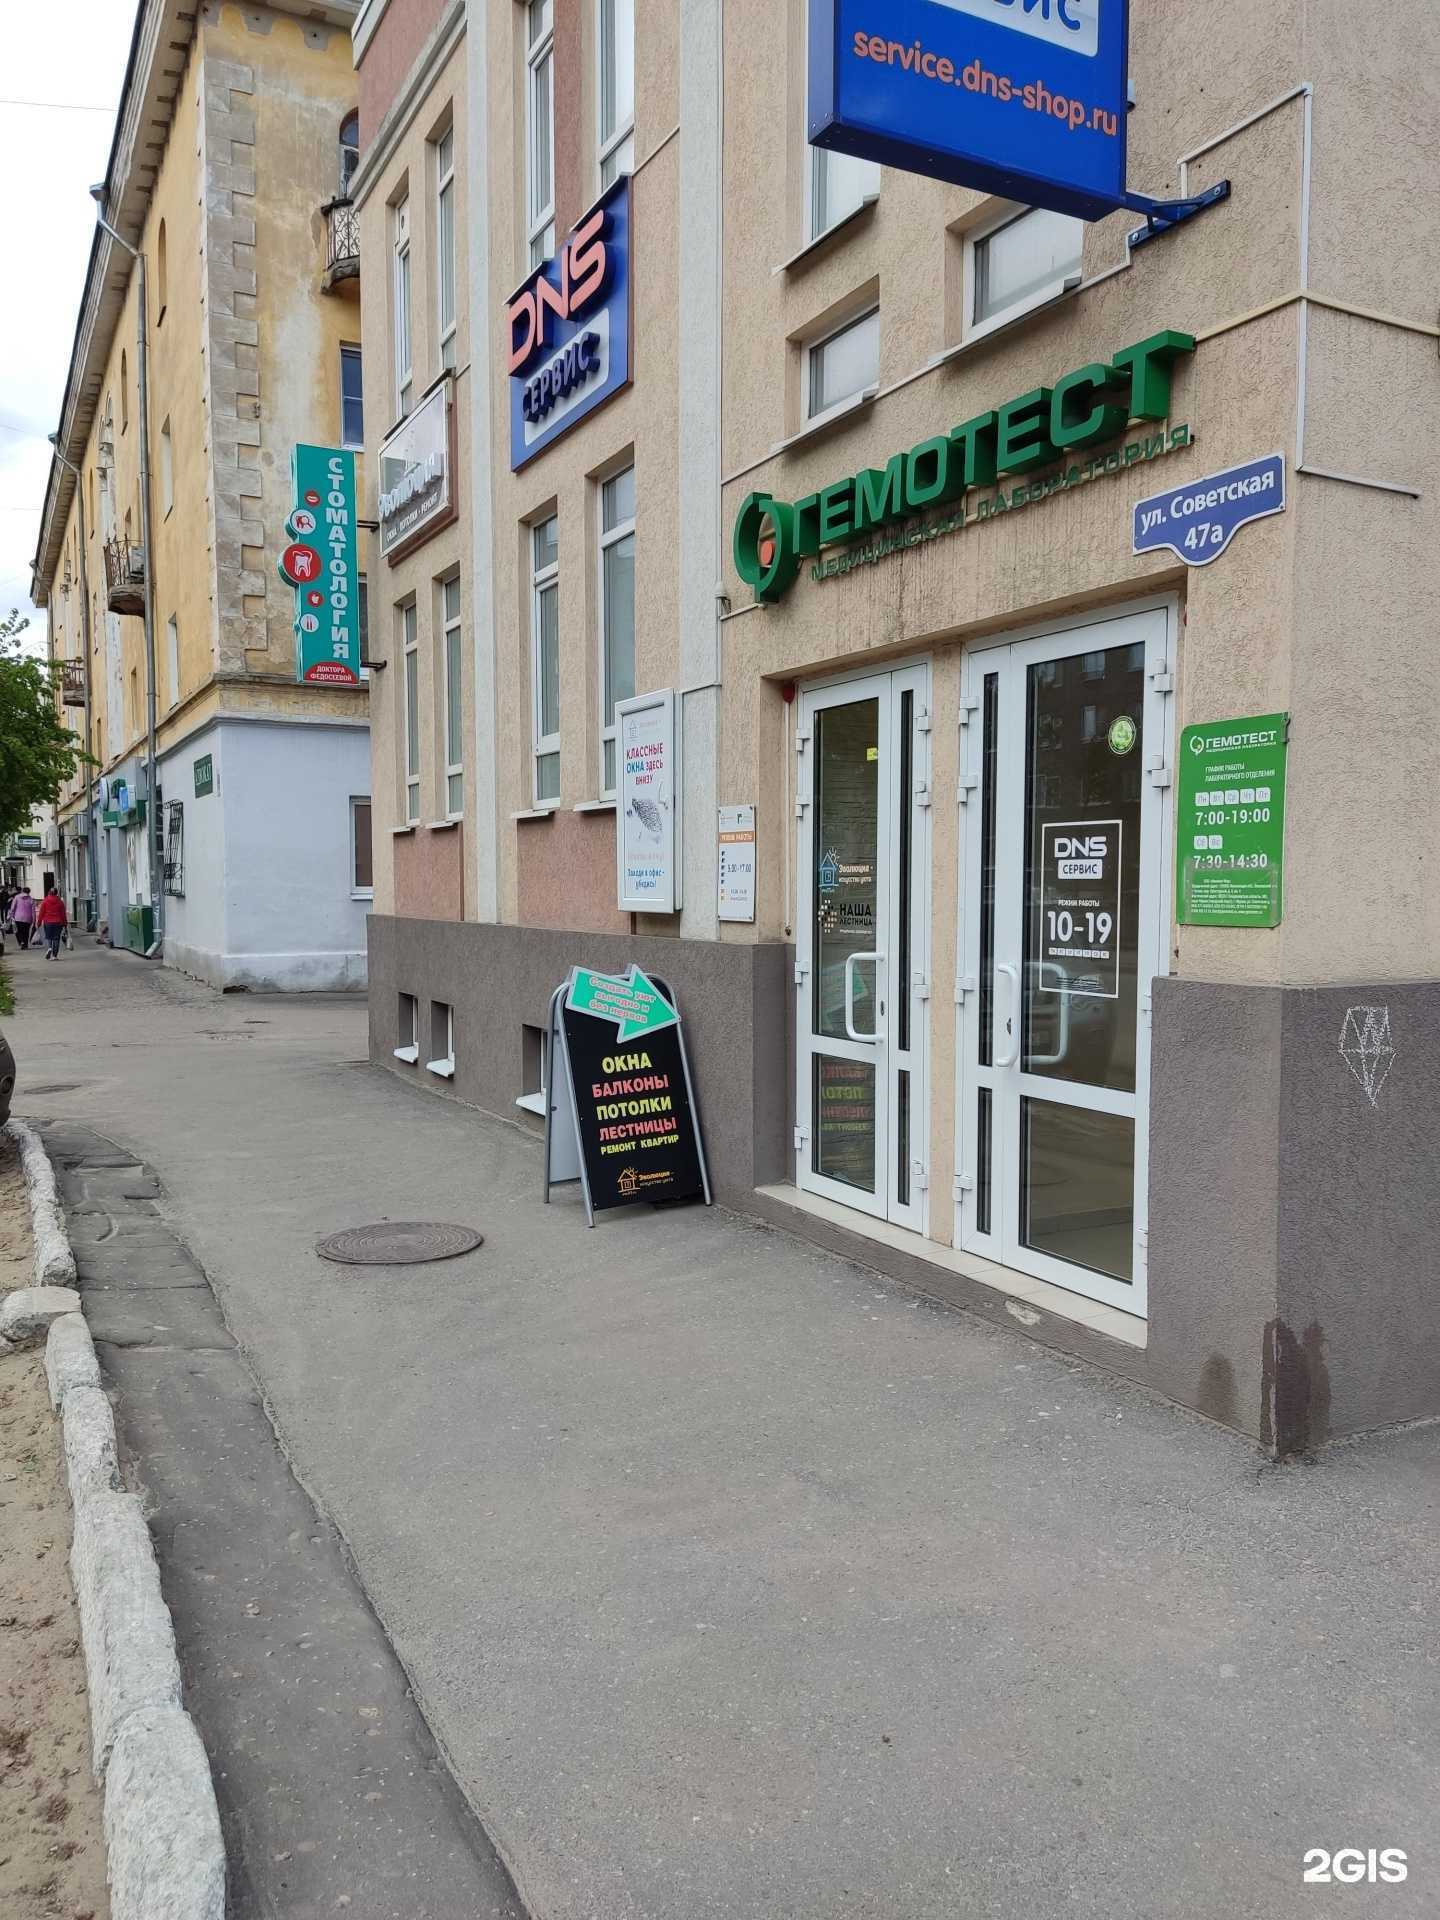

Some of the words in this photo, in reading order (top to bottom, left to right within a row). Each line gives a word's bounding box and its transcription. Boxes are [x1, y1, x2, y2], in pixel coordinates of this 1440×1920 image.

[853, 28, 1118, 137] service.dns-shop.ru
[507, 208, 607, 377] DNS
[522, 331, 601, 423] СЕРВИС
[792, 330, 1196, 556] ГЕМОТЕСТ
[1141, 508, 1167, 535] ул.
[1170, 470, 1275, 518] Советская
[1184, 522, 1224, 550] 47а
[325, 457, 350, 660] СТОМАТОЛОГИЯ
[316, 665, 346, 675] ДОКТОРА
[1205, 730, 1277, 749] ГЕМОТЕСТ
[626, 742, 664, 760] КЛАССНЫЕ
[626, 760, 645, 774] ОКНА
[645, 758, 664, 773] ЗДЕСЬ
[1224, 762, 1245, 772] РАБОТЫ
[1245, 769, 1276, 779] ОТДЕЛЕНИЯ
[635, 774, 654, 786] ВНИЗУ
[1195, 808, 1270, 826] 7:00-19:00
[1054, 836, 1107, 858] DNS
[1062, 862, 1098, 875] СЕРВИС
[1193, 853, 1268, 869] 7:30-14:30
[840, 903, 872, 917] НАША
[1078, 899, 1100, 907] РАБОТЫ
[839, 917, 873, 926] ЛЕСТНИЦА
[1047, 911, 1112, 944] 10-19
[602, 1052, 652, 1074] ОКНА
[592, 1074, 669, 1098] БАЛКОНЫ
[596, 1096, 672, 1121] ПОТОЛКИ
[600, 1116, 677, 1142] ЛЕСТНИЦЫ
[601, 1141, 637, 1155] РЕМОНТ
[640, 1134, 680, 1149] КВАРТИР
